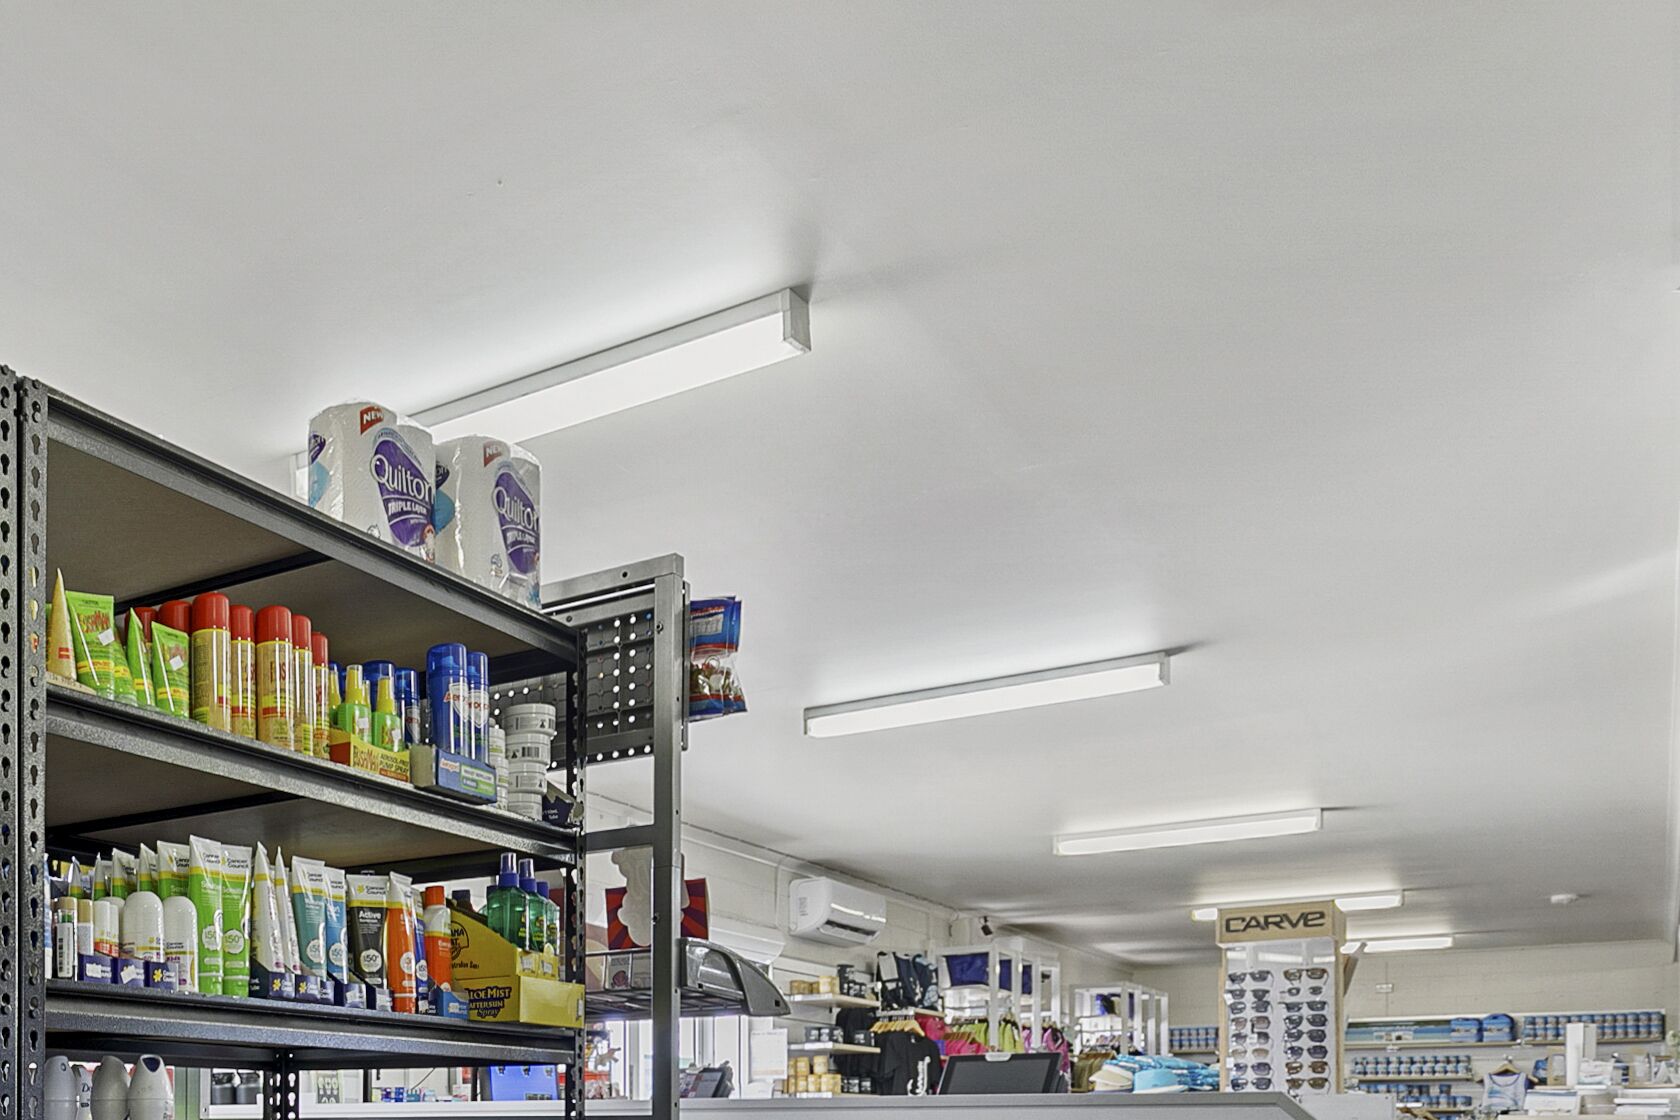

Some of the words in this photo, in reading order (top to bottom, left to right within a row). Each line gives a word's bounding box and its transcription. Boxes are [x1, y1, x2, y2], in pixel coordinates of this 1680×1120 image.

[363, 410, 385, 426] NEW
[371, 454, 434, 504] Quilton
[358, 910, 382, 920] Active
[1224, 909, 1326, 934] CARVE
